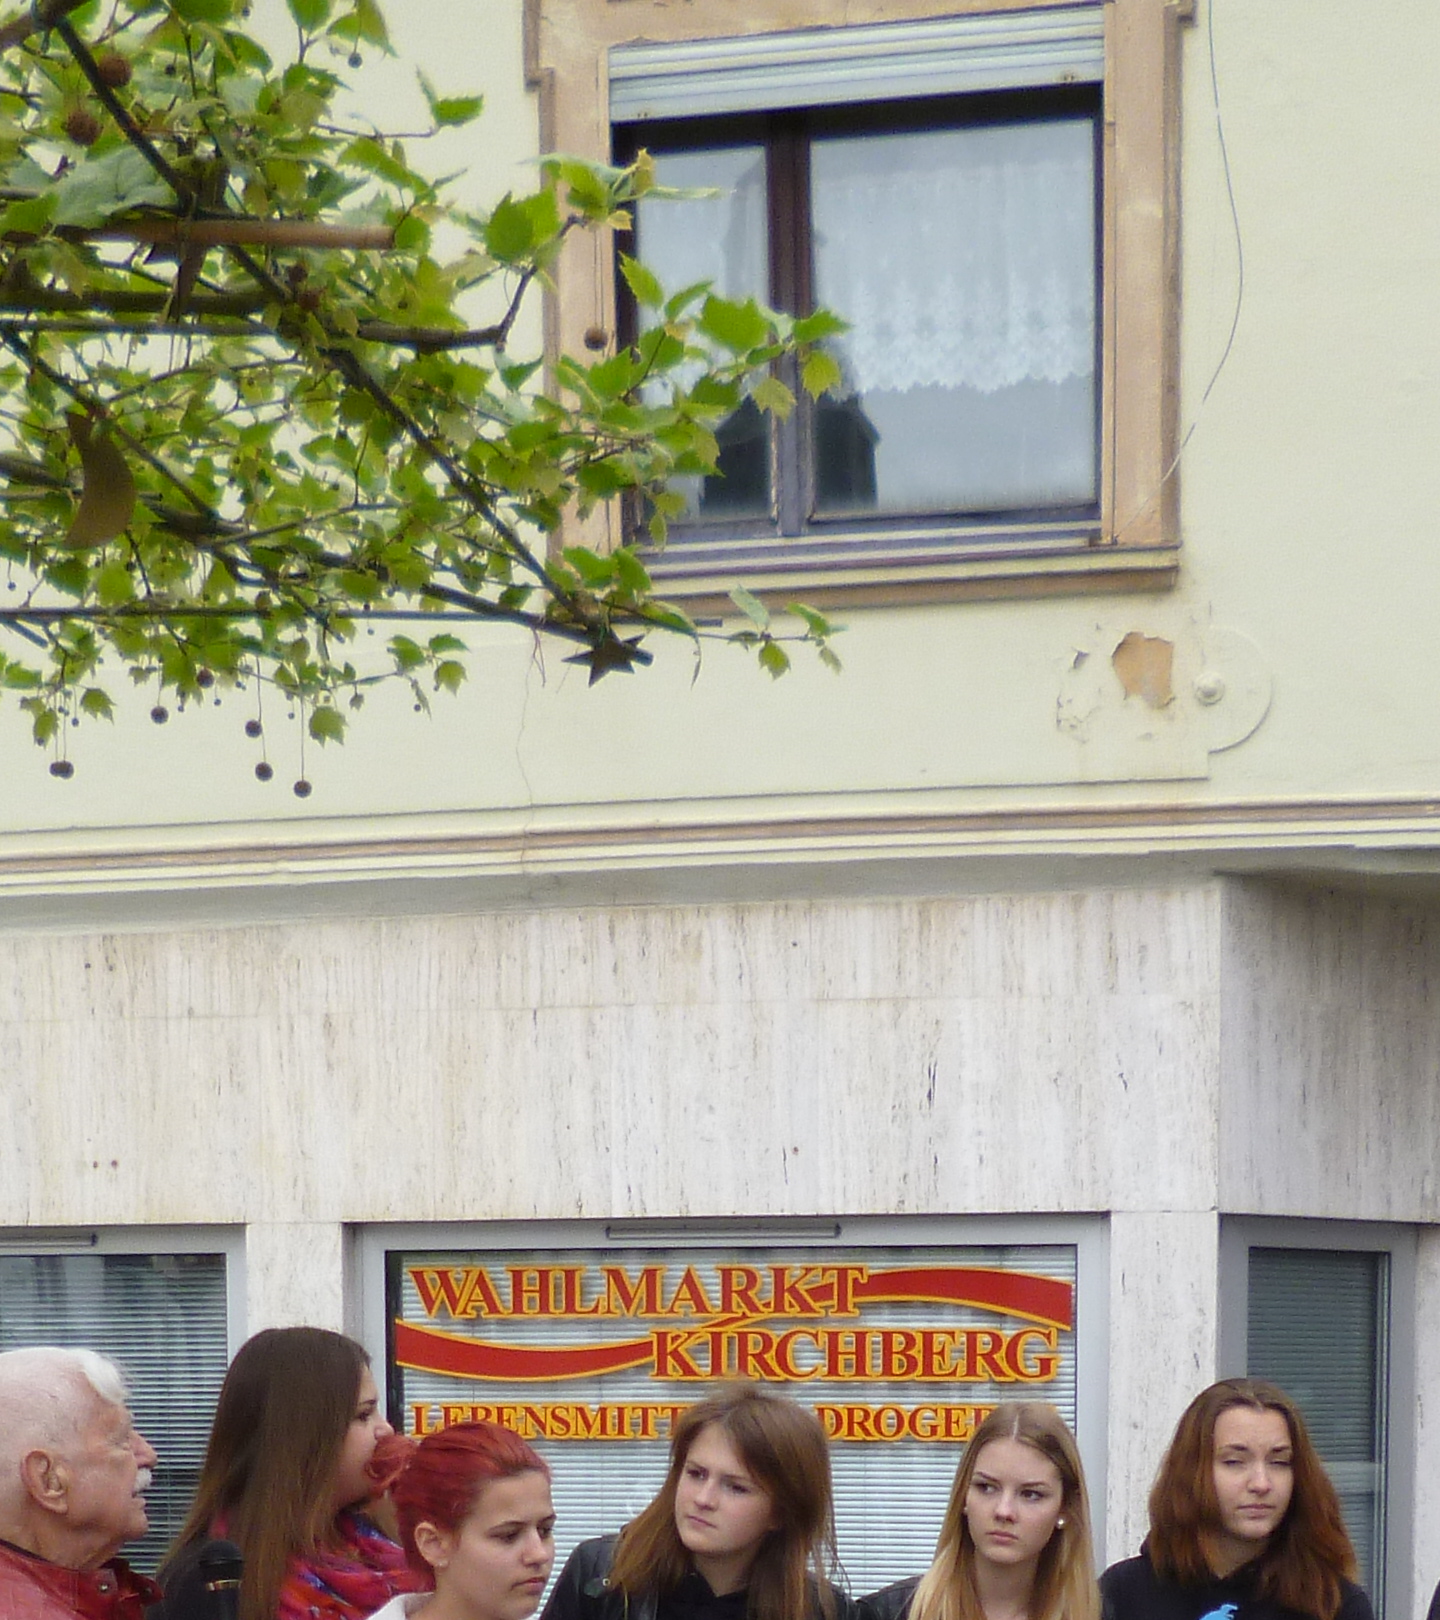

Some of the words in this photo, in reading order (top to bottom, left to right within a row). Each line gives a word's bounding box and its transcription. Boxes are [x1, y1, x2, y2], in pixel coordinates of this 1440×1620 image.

[409, 1265, 868, 1317] WAHLMARKT
[650, 1327, 1060, 1382] KIRCHBERG
[410, 1403, 686, 1441] LEBENSMITT
[815, 1404, 994, 1442] DROGE
